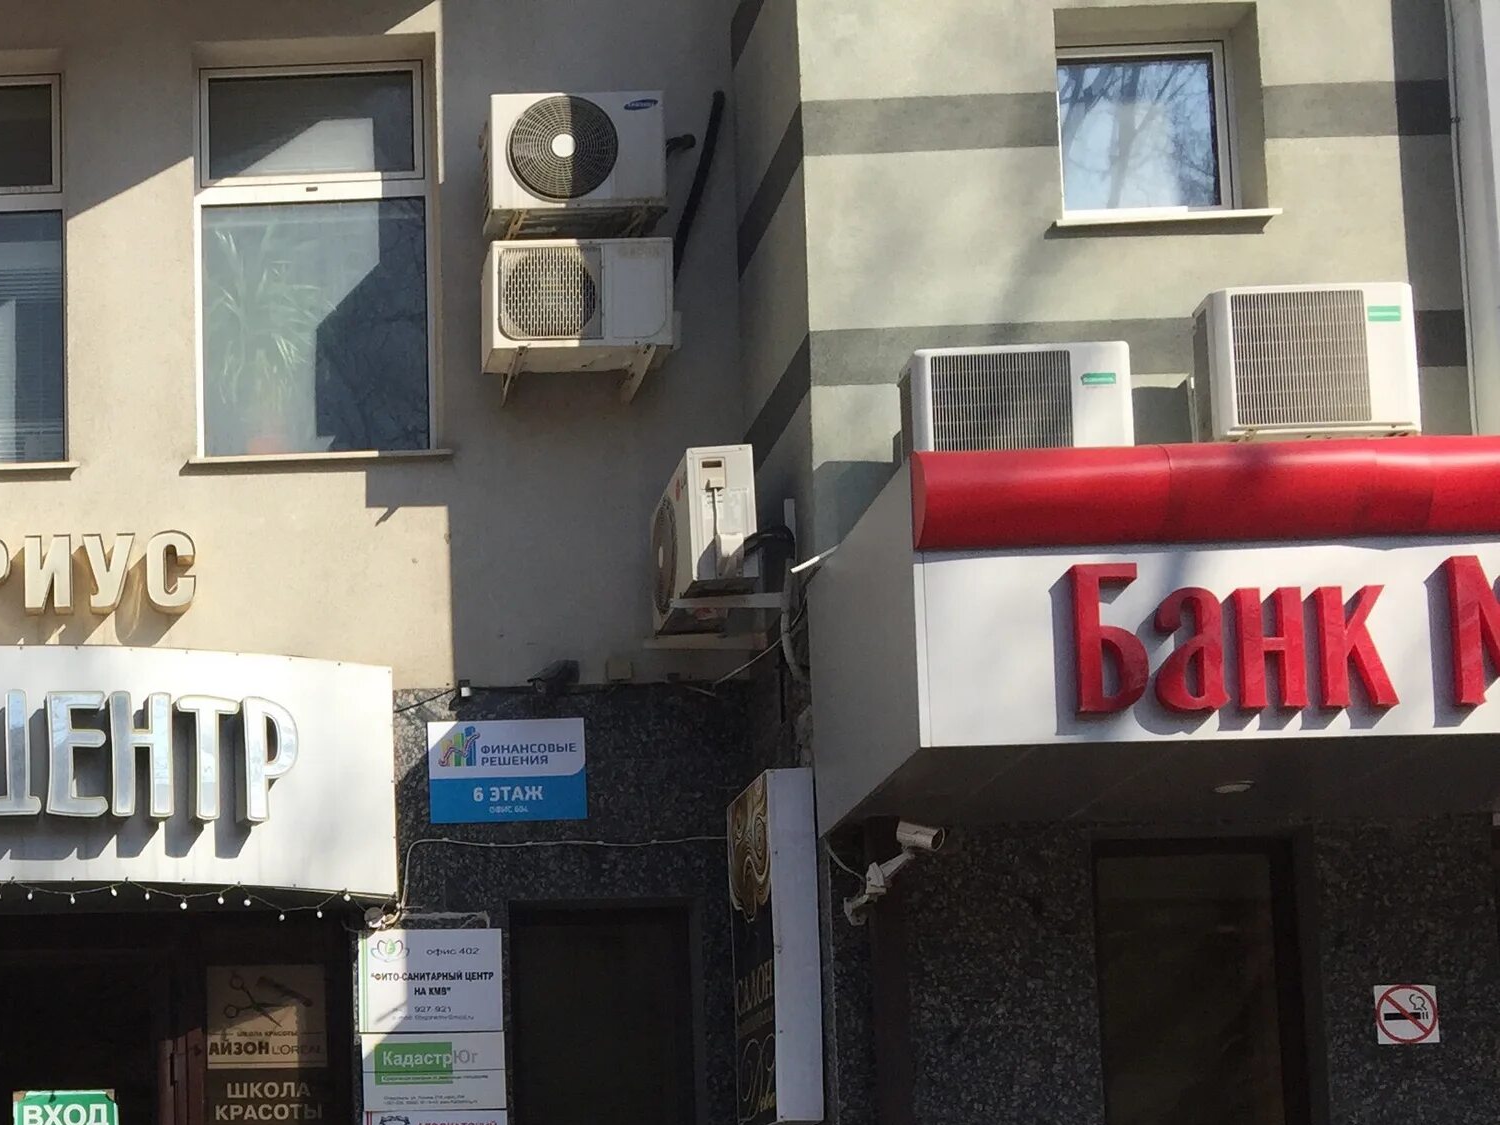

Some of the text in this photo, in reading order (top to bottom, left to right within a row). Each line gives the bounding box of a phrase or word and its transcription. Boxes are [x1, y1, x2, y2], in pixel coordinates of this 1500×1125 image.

[1070, 562, 1399, 714] Банк
[480, 742, 577, 755] ФИНАНСОВЫЕ
[480, 755, 549, 767] РЕШЕНИЯ
[473, 785, 544, 802] 6 ЭТАЖ
[489, 804, 513, 814] ОФИС
[425, 946, 480, 957] офис 402
[465, 971, 495, 984] ЦЕНТР
[413, 986, 427, 997] НА
[226, 1081, 311, 1099] ШКОЛА
[214, 1103, 323, 1121] КРАСОТЫ
